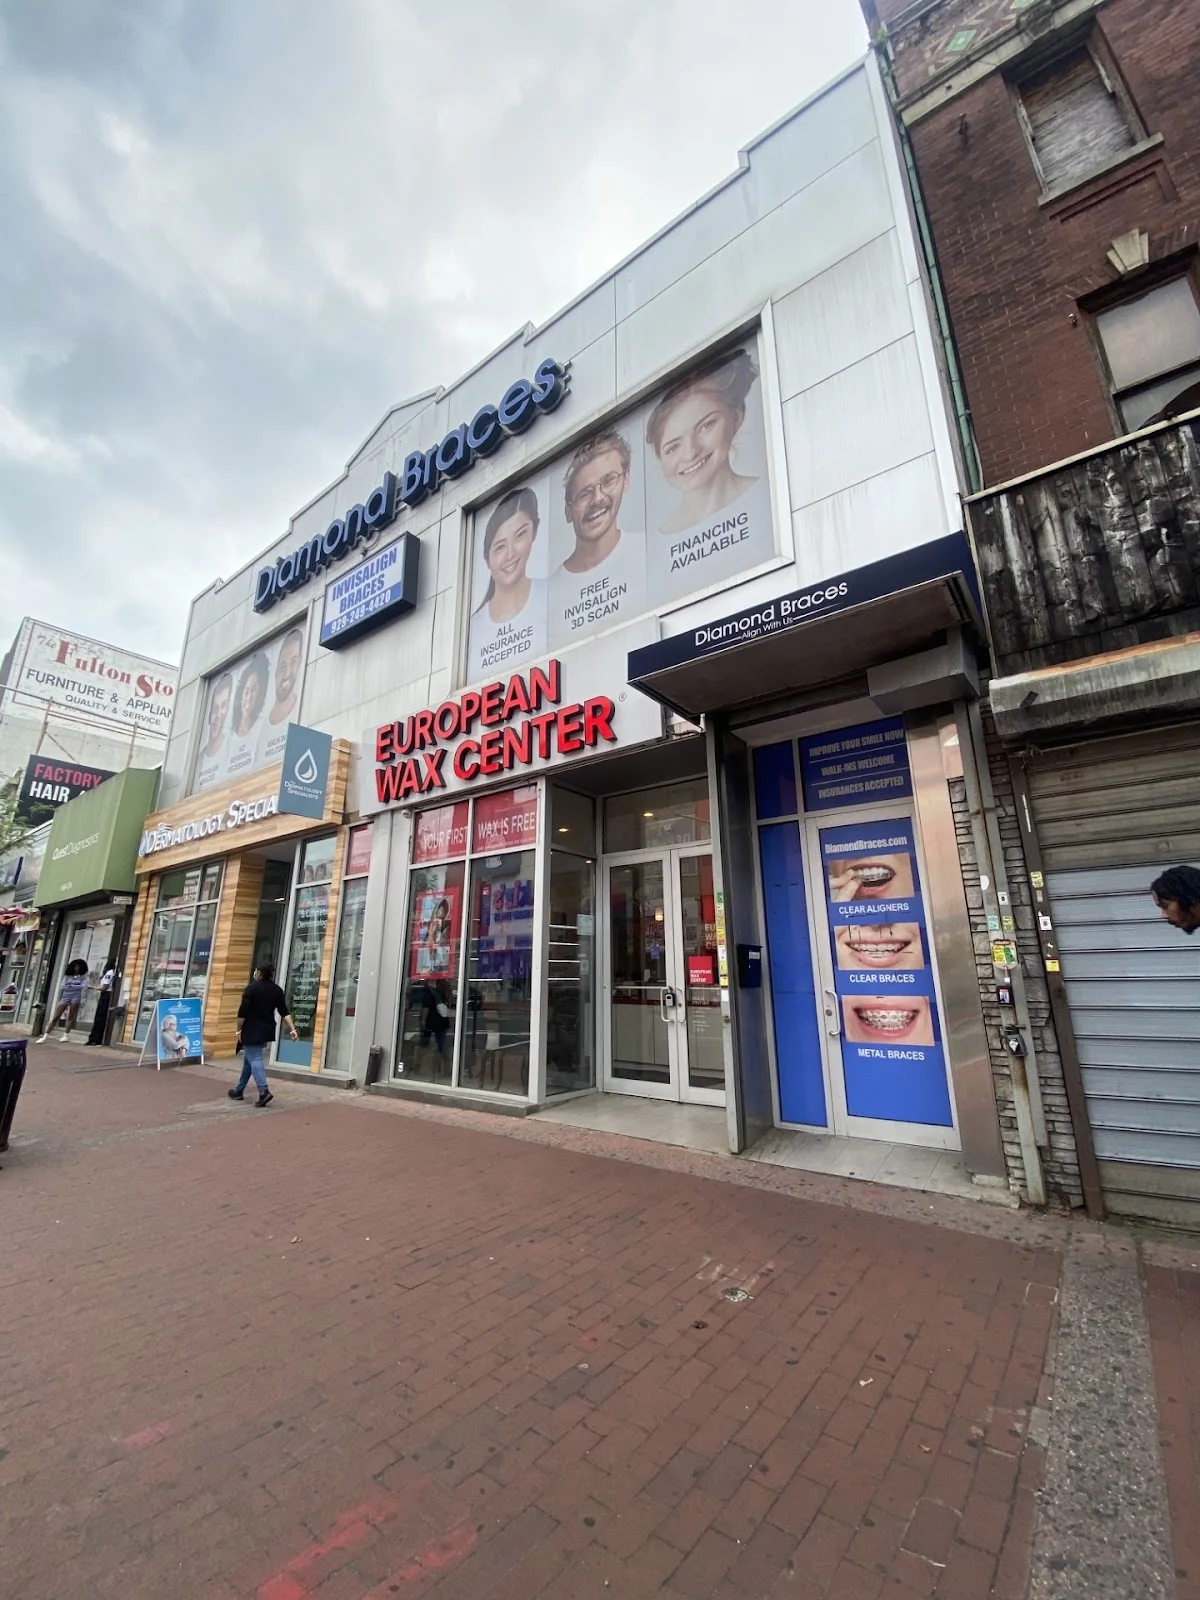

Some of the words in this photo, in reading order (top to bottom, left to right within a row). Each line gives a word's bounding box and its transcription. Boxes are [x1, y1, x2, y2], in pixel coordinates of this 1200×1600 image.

[253, 471, 396, 613] Diamond
[401, 357, 563, 505] Braces
[670, 512, 749, 557] FINANCING
[670, 527, 750, 572] AVAILABLE
[332, 547, 397, 601] INVISALIGN
[580, 577, 610, 599] FREE
[339, 573, 385, 614] BRACES
[564, 583, 627, 619] INVISALIGN
[331, 590, 391, 633] 929-249-4420
[571, 617, 585, 630] 3D
[587, 600, 619, 625] SCAN
[695, 605, 775, 646] Diamond
[780, 582, 848, 616] Braces
[480, 626, 533, 657] INSURANCE
[496, 623, 514, 638] ALL
[741, 626, 762, 640] Align
[763, 621, 782, 632] With
[783, 617, 794, 626] Us
[55, 640, 132, 685] Fulton
[134, 674, 174, 699] Sto
[481, 640, 531, 669] ACCEPTED
[26, 668, 105, 700] FURNITURE
[110, 693, 119, 704] &
[65, 694, 108, 711] QUALITY
[112, 706, 118, 714] &
[123, 710, 161, 726] SERVICE
[376, 659, 561, 762] EUROPEAN
[375, 749, 448, 803] WAX
[454, 696, 617, 780] CENTER
[809, 742, 841, 757] IMPROVE
[841, 738, 861, 749] YOUR
[861, 733, 884, 746] SMILE
[885, 728, 904, 741] NOW
[34, 763, 103, 788] FACTORY
[821, 761, 857, 776] WALK-INS
[857, 754, 895, 770] WELCOME
[29, 781, 70, 803] HAIR
[818, 782, 864, 799] INSURANCES
[864, 776, 904, 791] ACCEPTED
[146, 812, 226, 854] DERMATOLOGY
[423, 831, 445, 850] YOUR
[446, 826, 469, 846] FIRST
[478, 820, 498, 840] WAX
[501, 818, 509, 836] IS
[511, 812, 536, 834] FREE
[825, 836, 908, 854] DiamondBraces.com
[839, 905, 866, 915] CLEAR
[866, 902, 910, 914] ALIGNERS
[850, 974, 878, 983] CLEAR
[879, 974, 915, 983] BRACES
[858, 1048, 886, 1059] METAL
[887, 1050, 925, 1061] BRACES
